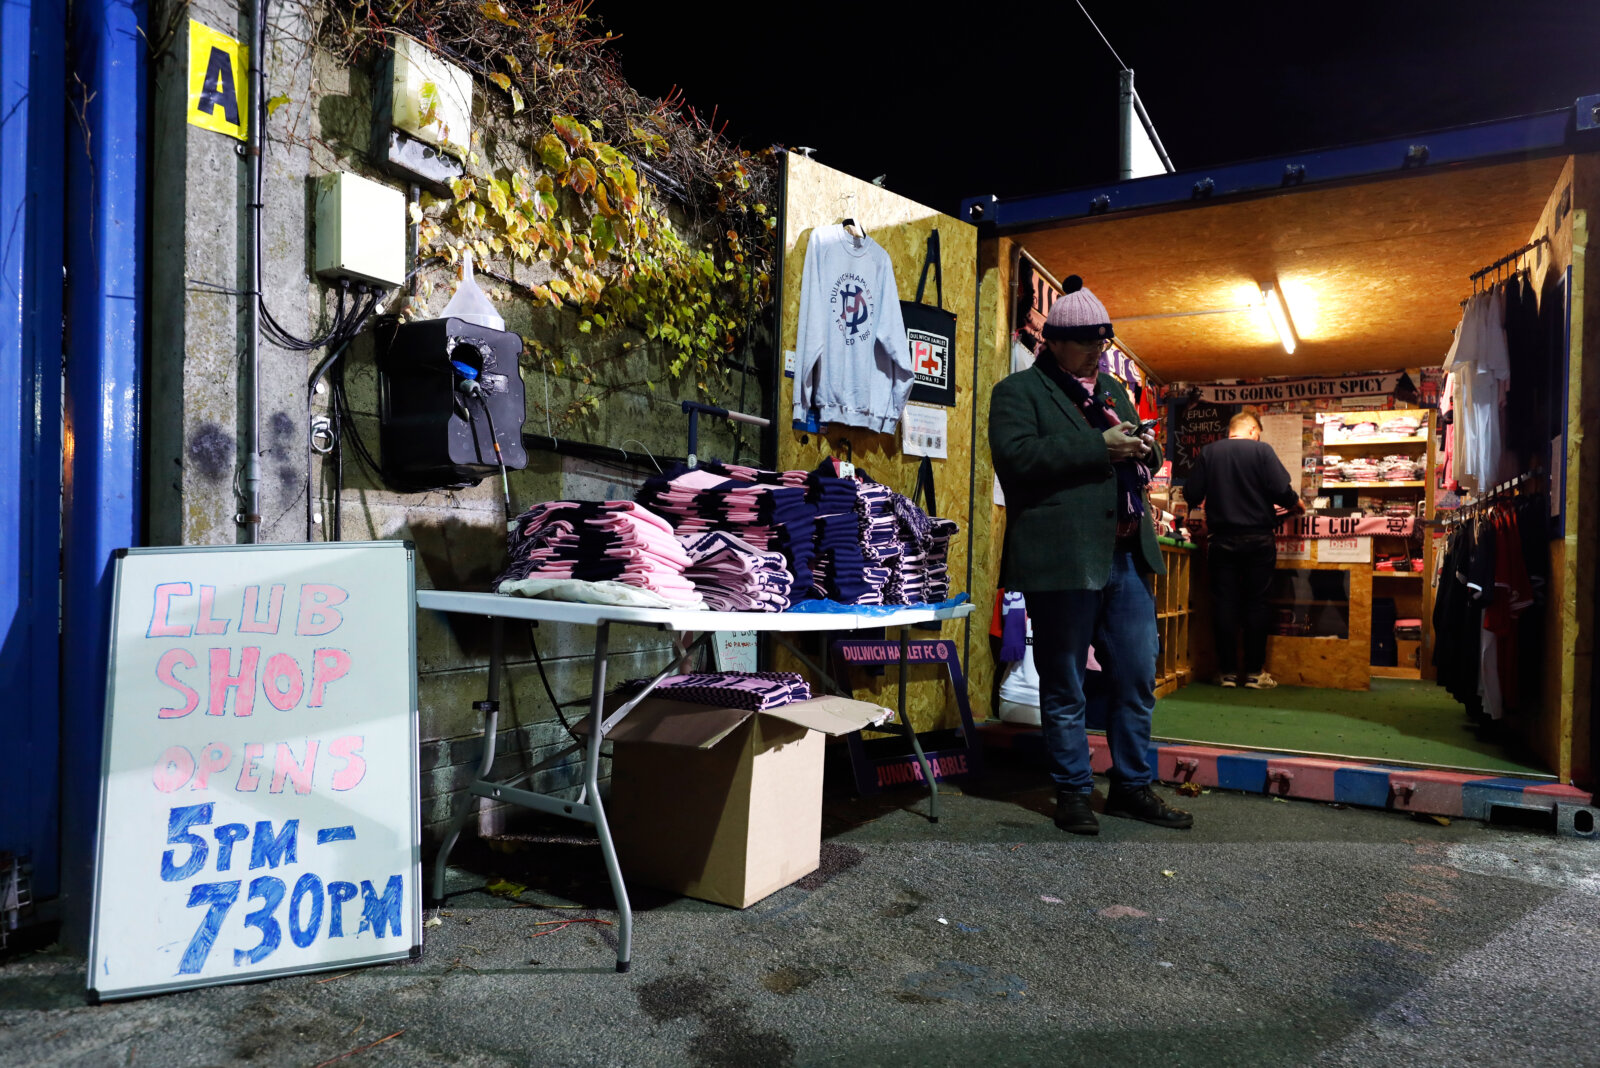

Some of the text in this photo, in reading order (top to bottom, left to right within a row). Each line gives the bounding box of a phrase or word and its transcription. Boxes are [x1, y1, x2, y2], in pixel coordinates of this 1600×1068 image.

[197, 45, 240, 126] A
[830, 273, 849, 303] DULWICH
[909, 333, 930, 342] DULWICH
[1214, 377, 1387, 401] ITS GOING TO GET SPICY
[1186, 408, 1219, 420] EPLICA
[1181, 434, 1197, 445] ON
[1189, 421, 1221, 433] SHIRTS
[1293, 515, 1321, 535] THE
[1328, 518, 1360, 535] CUP
[1330, 538, 1357, 549] DHST
[145, 581, 349, 639] CLUB
[842, 645, 935, 661] DULWICH HALET FC
[155, 646, 352, 719] SHOP
[151, 735, 367, 795] OPENS
[876, 761, 923, 787] JUNIOR
[160, 801, 300, 882] 5PM
[174, 872, 403, 976] 730PM
